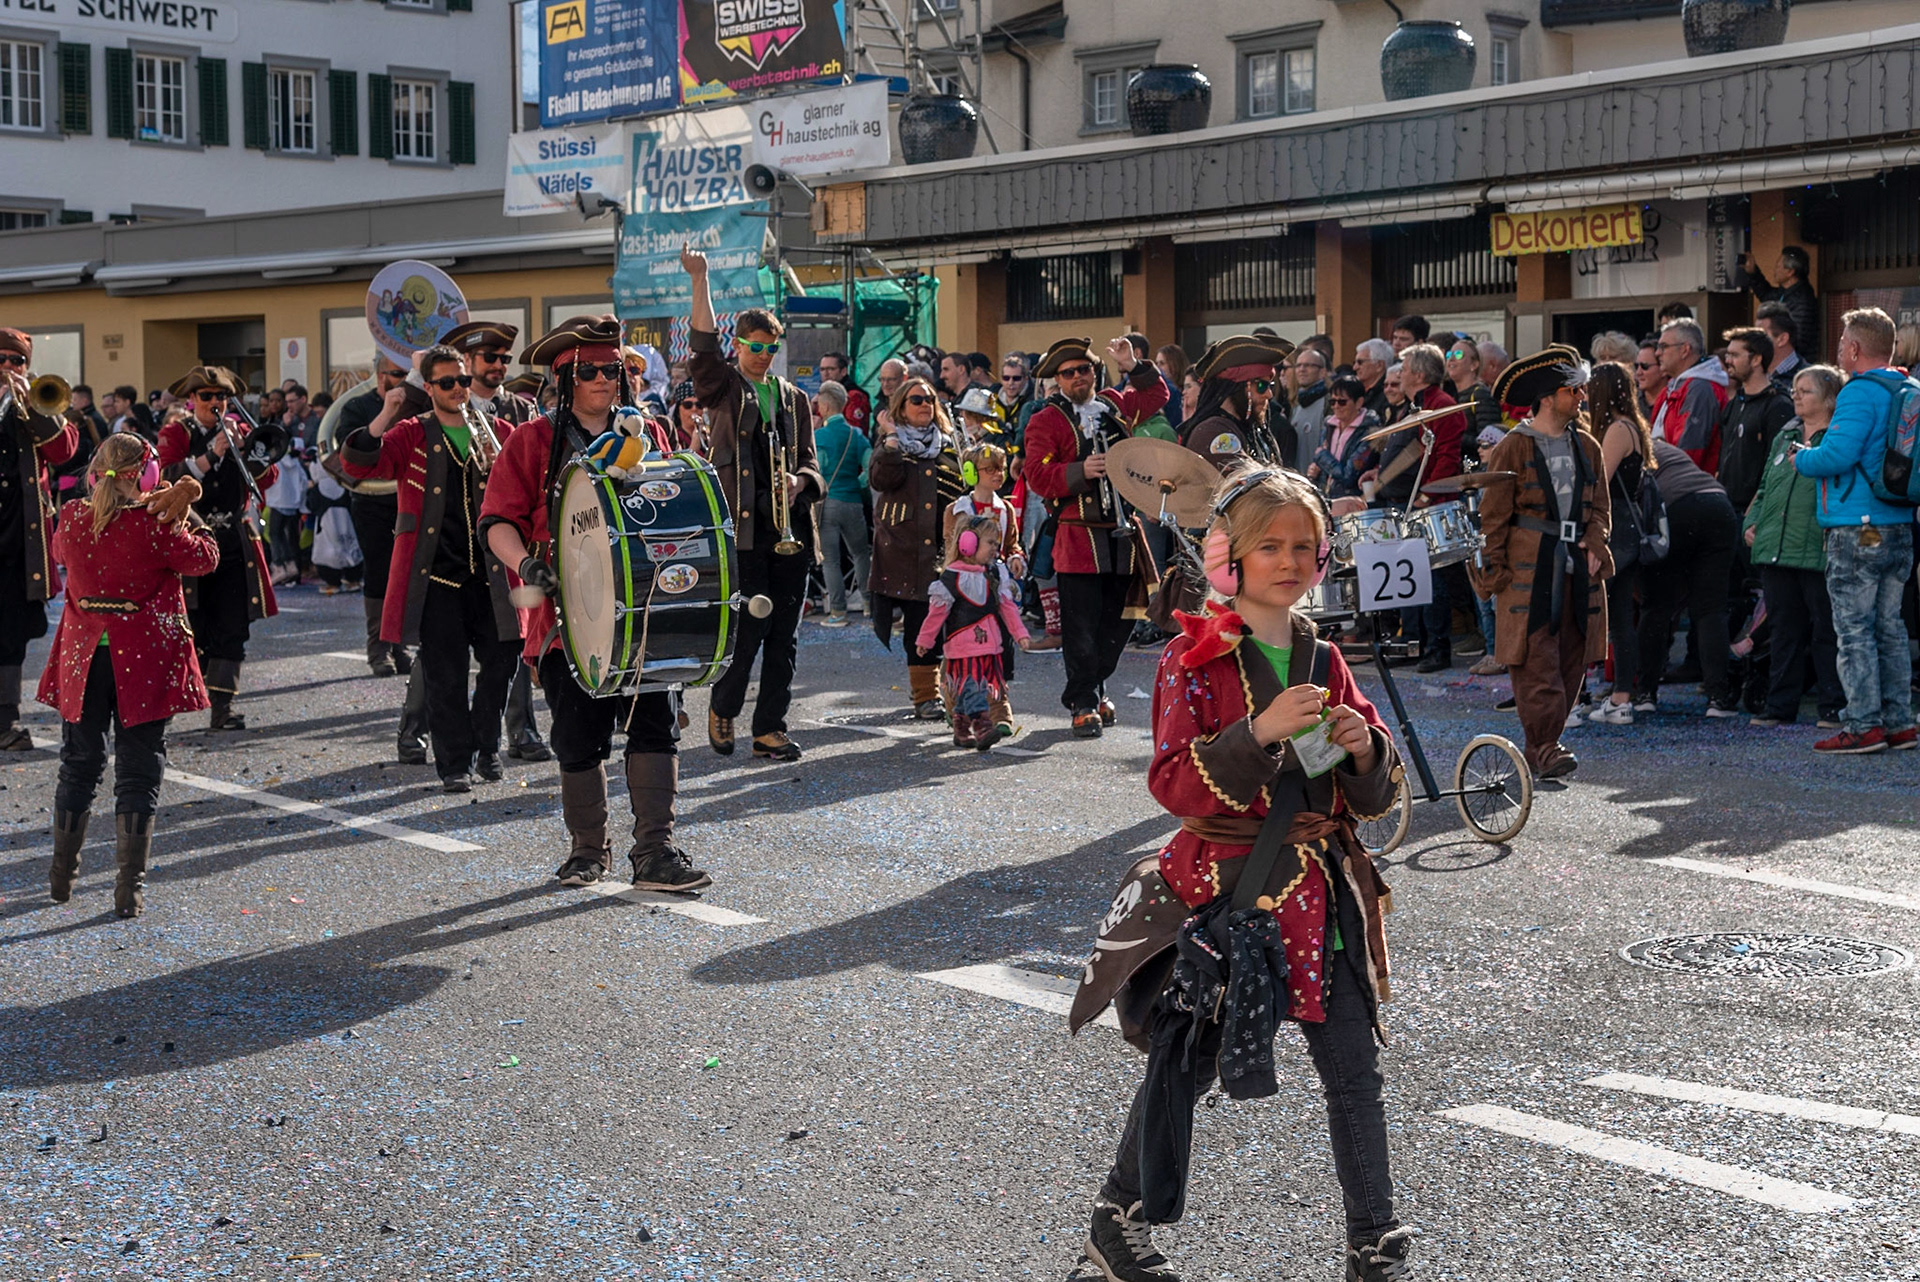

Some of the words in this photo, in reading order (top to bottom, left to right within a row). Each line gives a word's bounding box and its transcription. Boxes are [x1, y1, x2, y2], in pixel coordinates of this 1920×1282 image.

[78, 0, 218, 31] SCHWERT
[549, 5, 583, 39] FA
[719, 0, 800, 25] SWISS
[720, 14, 800, 37] WERBETECHNIK
[582, 82, 653, 111] Bedachungen
[655, 76, 671, 99] AG
[804, 103, 844, 125] glarner
[787, 120, 859, 144] haustechnik
[863, 120, 880, 137] ag
[539, 136, 596, 160] Stüssi
[643, 144, 742, 187] HAUSER
[538, 172, 593, 195] Näfels
[646, 175, 750, 211] HOLZBA
[1494, 203, 1638, 250] Dekoriert
[745, 252, 757, 267] AG
[1714, 236, 1726, 285] BISTRO
[630, 326, 661, 347] STEIN
[576, 506, 600, 534] SONOR
[1373, 559, 1416, 601] 23
